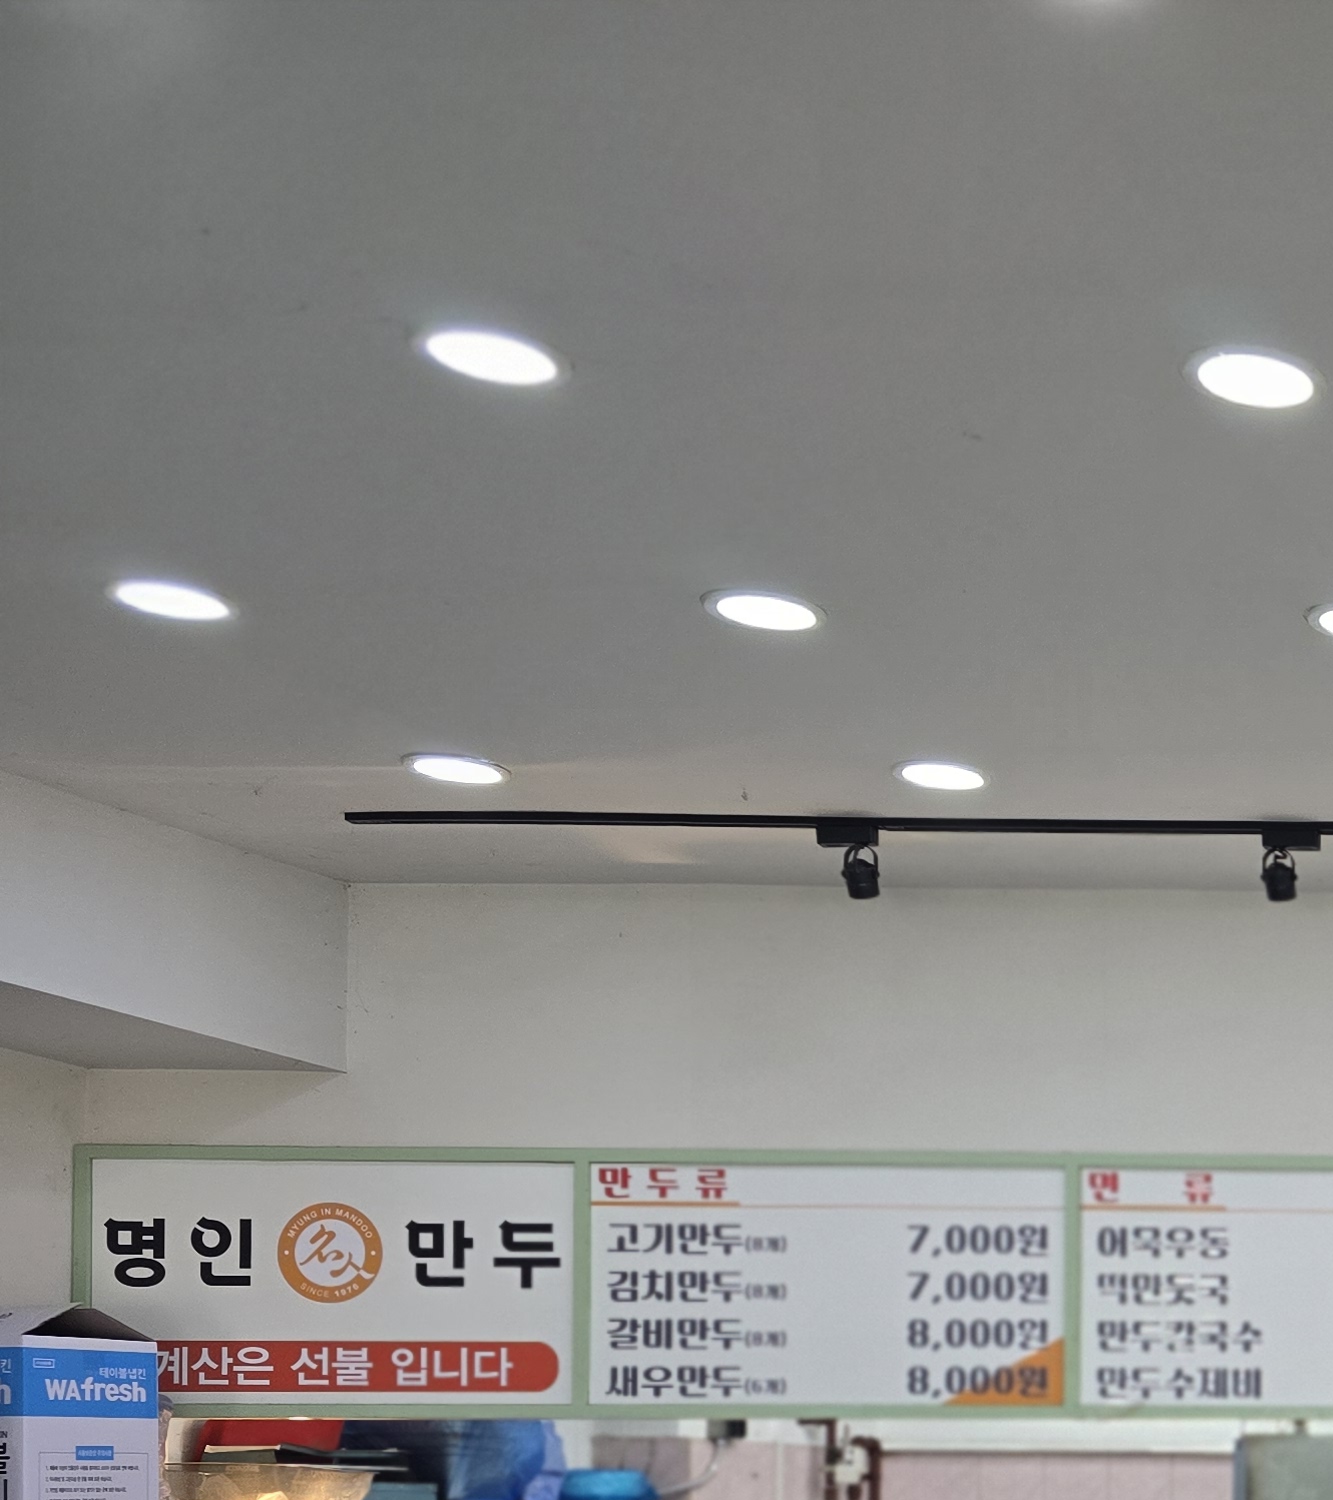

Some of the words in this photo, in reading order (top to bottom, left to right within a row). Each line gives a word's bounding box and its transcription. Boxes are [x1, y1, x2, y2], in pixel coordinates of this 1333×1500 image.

[287, 1211, 317, 1238] MYUNG
[335, 1209, 372, 1238] MANDOO
[103, 1216, 252, 1288] 명인
[405, 1220, 561, 1289] 만두
[909, 1225, 1048, 1257] 7,000원
[1097, 1226, 1228, 1259] 어묵우동
[300, 1283, 329, 1297] SINCE
[335, 1284, 359, 1297] 1976
[910, 1272, 1049, 1304] 7,000원
[907, 1319, 1049, 1351] 8,000원
[1096, 1320, 1262, 1353] 만두칼국수
[99, 1367, 147, 1379] 테이블냅킨
[157, 1346, 274, 1387] 계산은
[290, 1346, 374, 1386] 선불
[391, 1347, 514, 1387] 입니다
[907, 1365, 1049, 1399] 8,000원
[45, 1377, 147, 1402] WAfresh
[1096, 1367, 1263, 1400] 만두수제비
